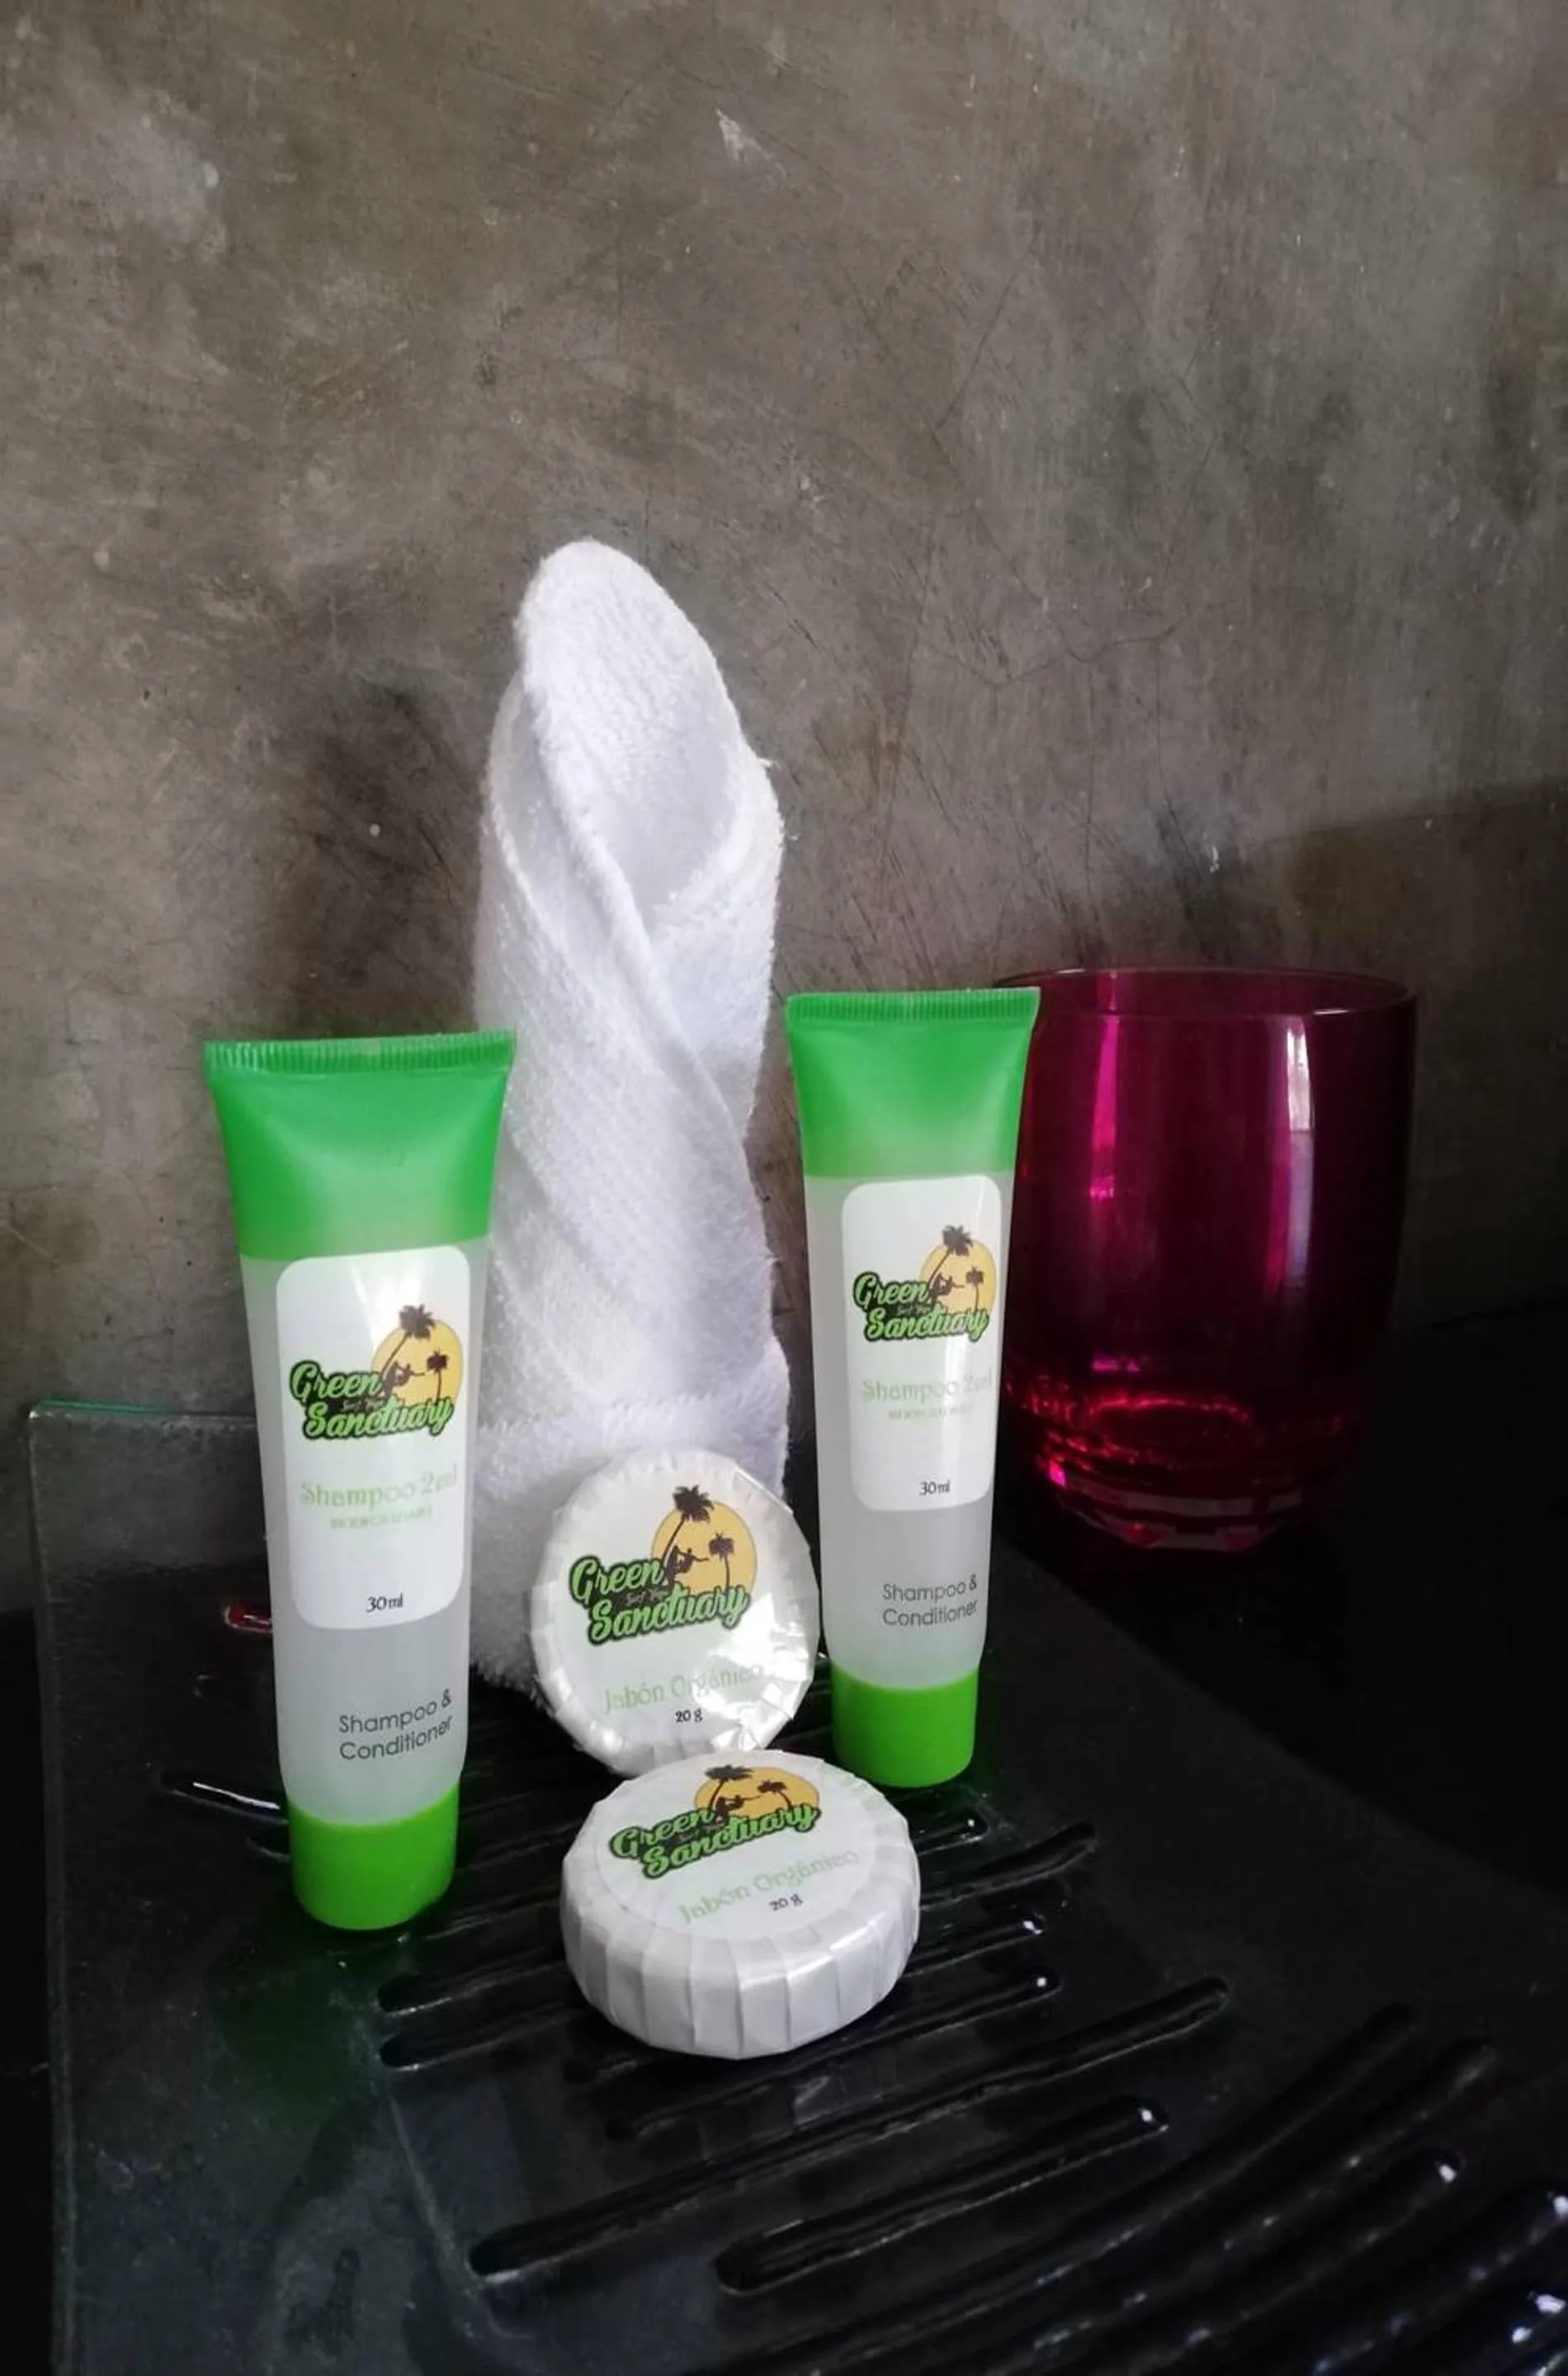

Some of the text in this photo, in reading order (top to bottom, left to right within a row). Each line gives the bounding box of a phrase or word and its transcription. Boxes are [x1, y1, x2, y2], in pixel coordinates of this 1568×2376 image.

[853, 1272, 930, 1311] Green
[864, 1302, 989, 1342] Sanctuary
[290, 1360, 383, 1402] Green
[862, 1377, 958, 1405] Shampoo
[304, 1396, 454, 1438] Sanctuary
[300, 1480, 416, 1510] Shampoo
[569, 1556, 666, 1605] Green
[882, 1573, 977, 1603] Shampoo &
[588, 1582, 750, 1645] Sanctuary
[882, 1599, 978, 1627] Conditioner
[339, 1688, 452, 1734] Shampoo &
[604, 1682, 665, 1715] Jabón
[675, 1709, 692, 1723] 20
[339, 1715, 453, 1760] Conditioner
[609, 1807, 715, 1859] Green
[643, 1802, 822, 1878] Sanctuary
[678, 1849, 860, 1925] Jabón Orgánico
[769, 1897, 789, 1911] 20
